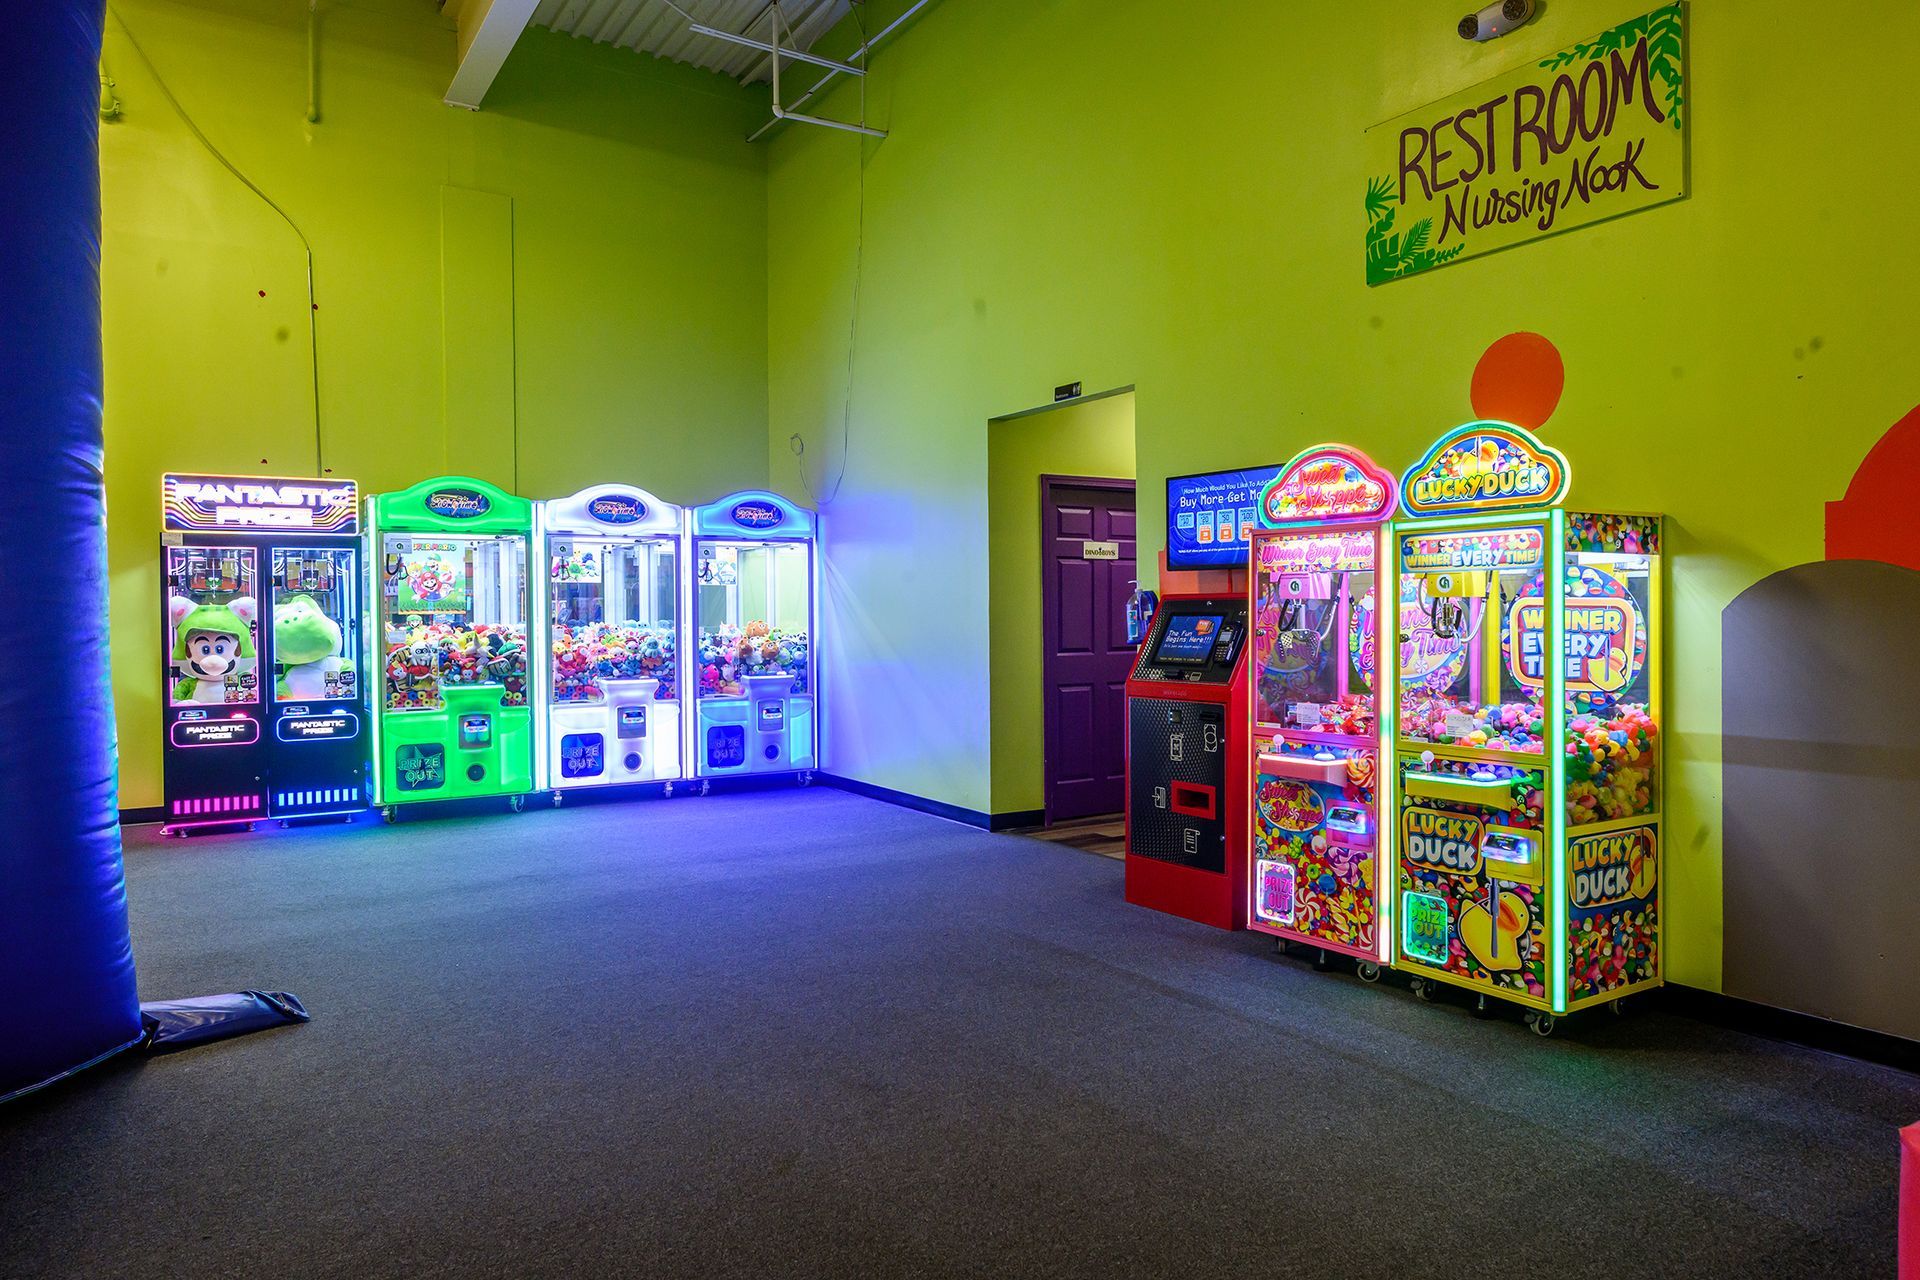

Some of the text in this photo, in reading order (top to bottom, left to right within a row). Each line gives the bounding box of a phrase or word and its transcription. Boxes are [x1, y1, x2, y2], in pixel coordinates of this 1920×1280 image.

[1438, 138, 1659, 244] Nursing Nook
[1292, 463, 1345, 495] Sweet
[1417, 467, 1549, 503] LUCKY DUCK
[1180, 496, 1197, 508] Buy
[1200, 494, 1224, 506] More
[1227, 491, 1246, 503] Get
[1261, 535, 1373, 565] Winner Every Time
[1406, 553, 1450, 568] WINNER
[1452, 548, 1503, 567] EVERY
[1166, 636, 1187, 644] Begins
[186, 725, 245, 734] FANTASTIC
[290, 720, 345, 729] FANTASTIC
[400, 757, 441, 771] PRIZE
[567, 758, 593, 770] OUT
[405, 769, 435, 783] OUT
[1259, 781, 1304, 802] Sweet
[1408, 812, 1478, 842] LUCKY
[1408, 836, 1477, 871] DUCK
[1573, 834, 1636, 871] LUCKY
[1576, 867, 1630, 900] DUCK
[1269, 892, 1289, 911] OUT
[1413, 920, 1443, 939] OUT
